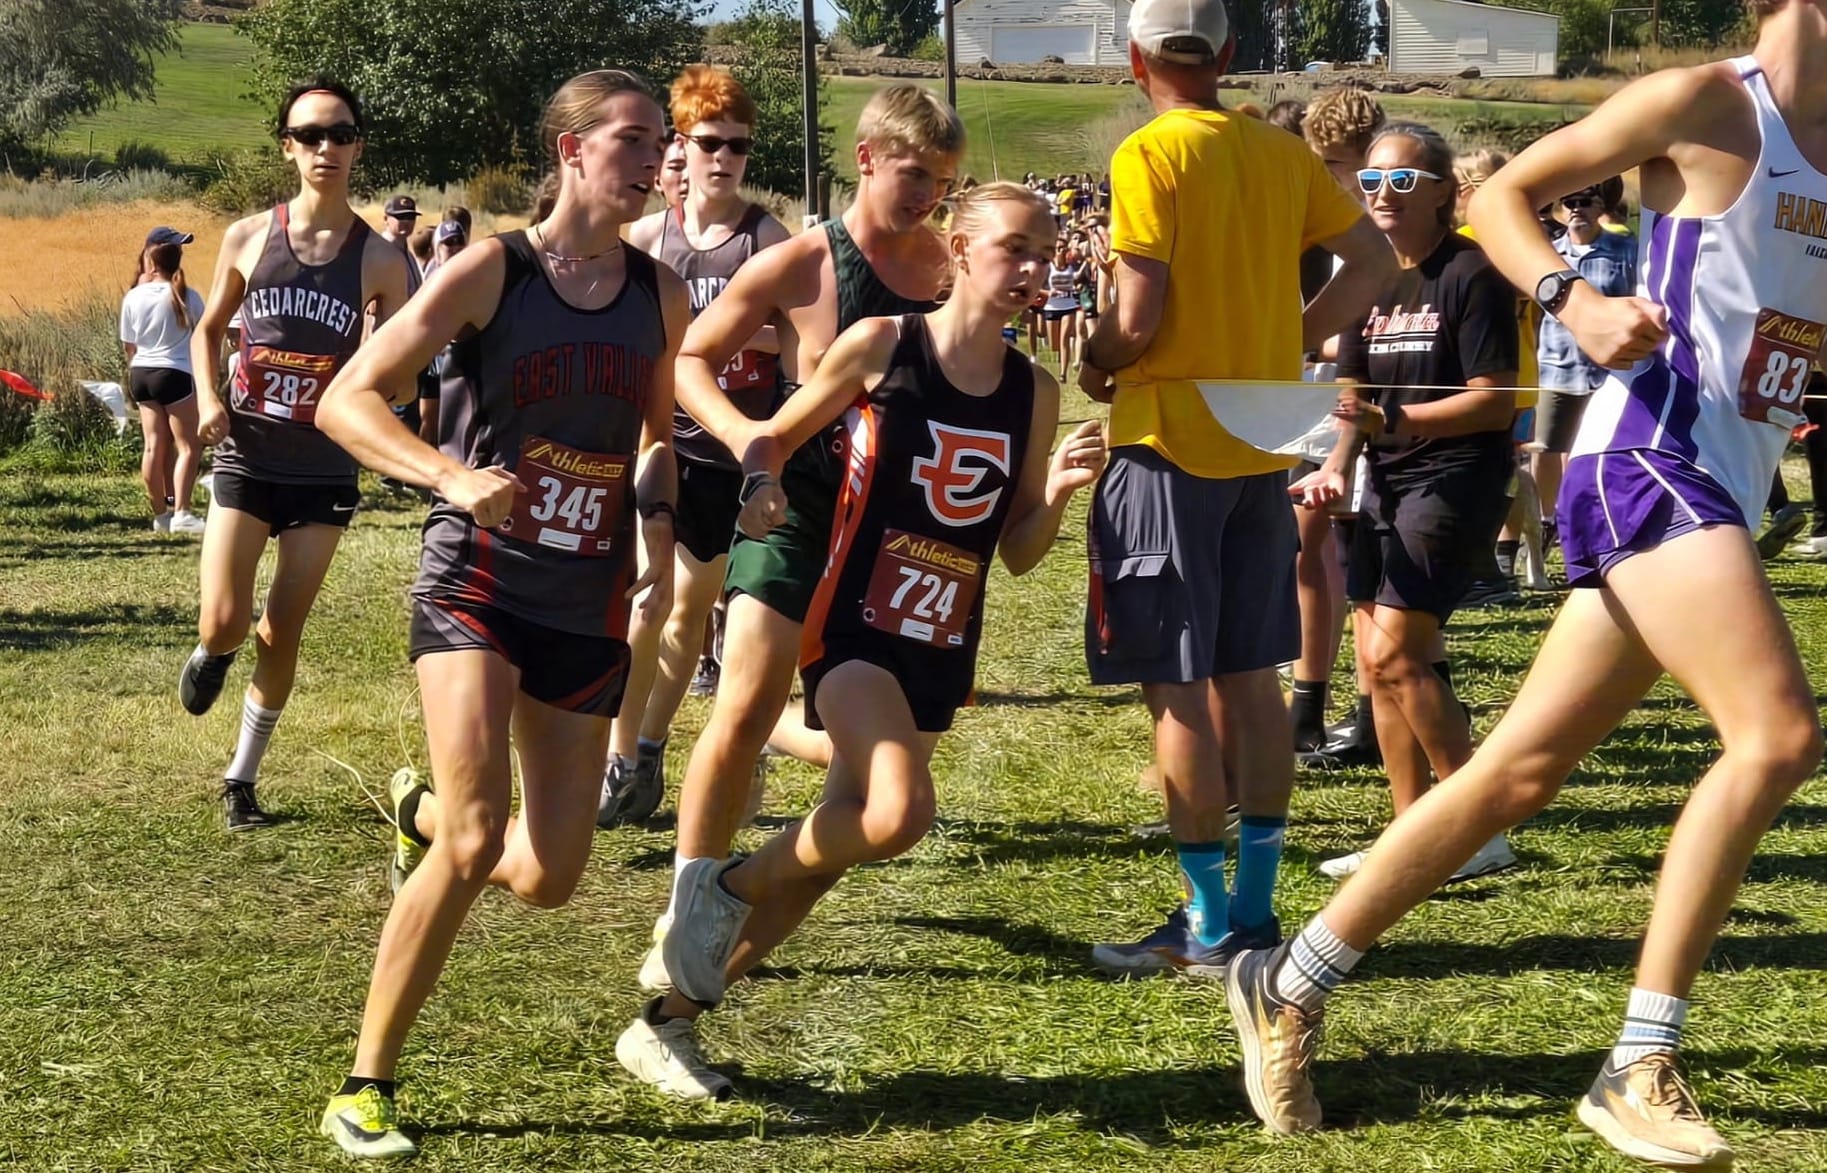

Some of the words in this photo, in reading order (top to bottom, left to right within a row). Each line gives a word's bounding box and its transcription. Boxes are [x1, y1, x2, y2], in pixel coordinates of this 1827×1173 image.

[1774, 192, 1827, 239] HAN
[251, 287, 357, 337] CEDARCREST
[263, 372, 318, 406] 282
[514, 343, 576, 409] EAST
[1757, 350, 1808, 404] 83
[911, 420, 1011, 527] E
[530, 476, 608, 532] 345
[889, 566, 959, 623] 724
